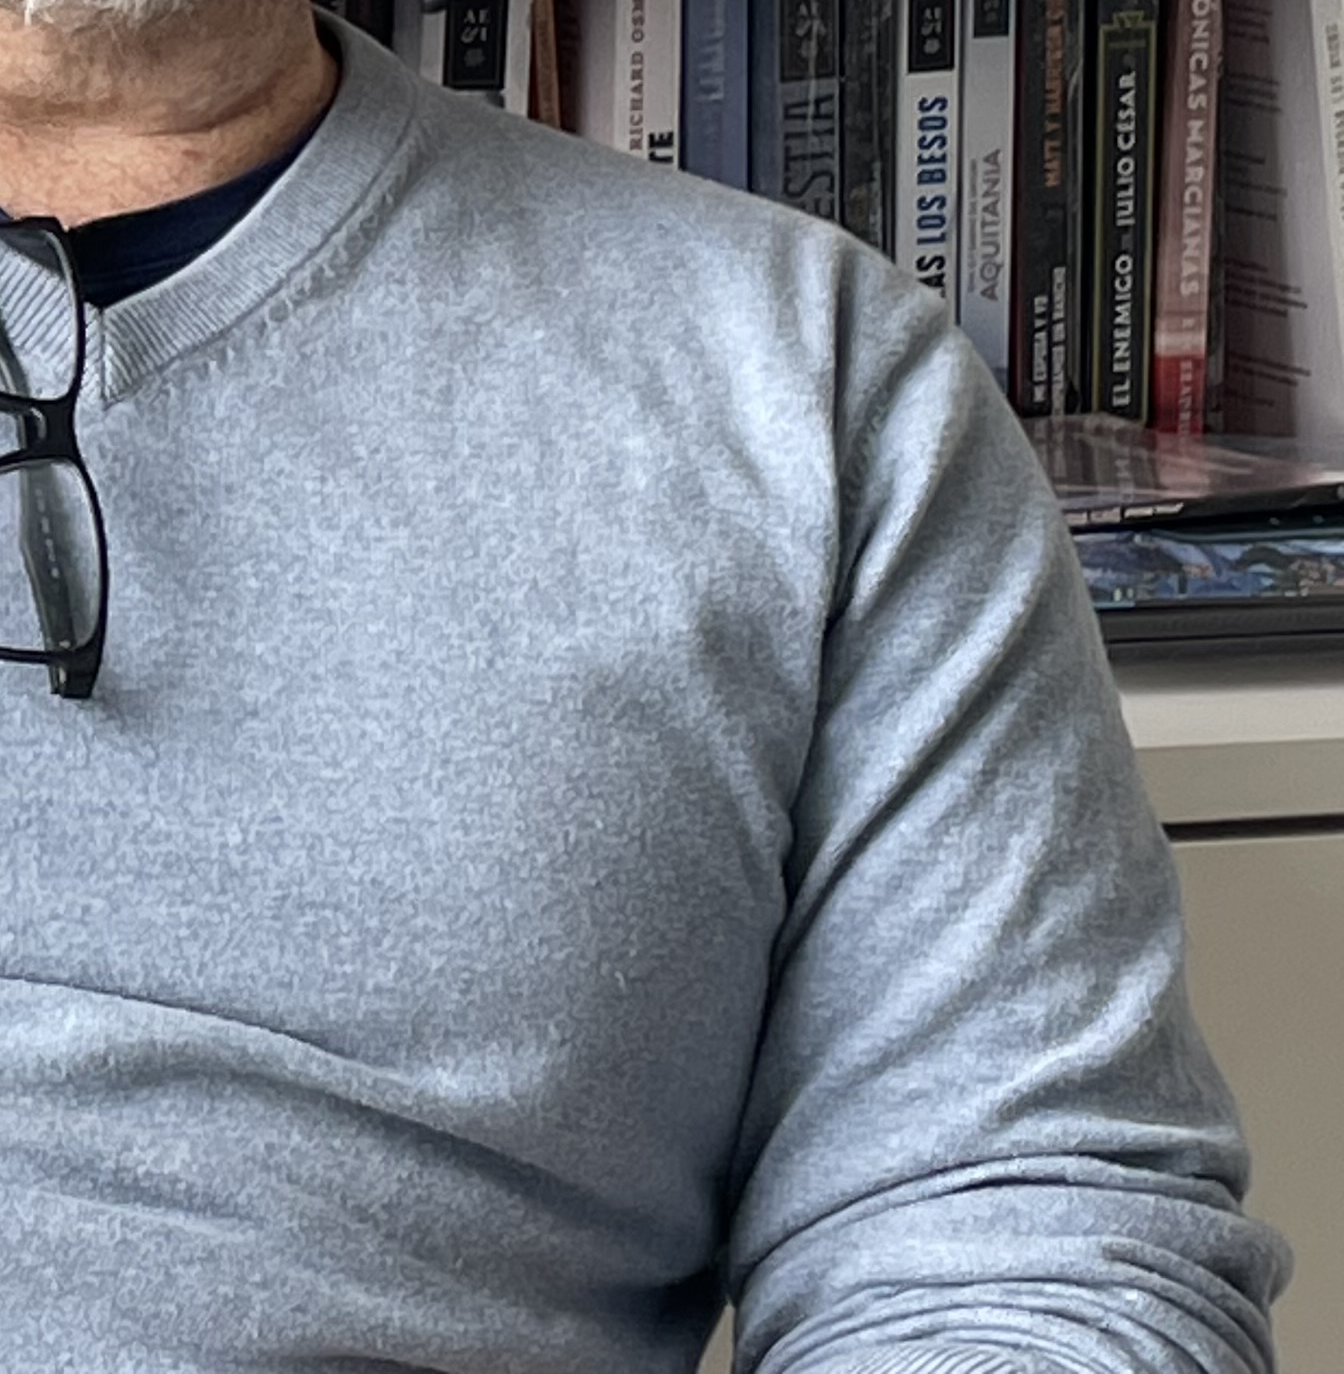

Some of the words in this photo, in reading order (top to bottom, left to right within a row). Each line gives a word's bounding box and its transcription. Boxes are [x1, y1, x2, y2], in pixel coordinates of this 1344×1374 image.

[628, 50, 646, 152] RICHARD
[915, 96, 948, 185] BESOS
[1111, 70, 1137, 151] CÉSAR
[915, 194, 948, 246] LOS
[977, 148, 1010, 302] AQUITANIA
[1114, 156, 1136, 227] JULIO
[1179, 118, 1206, 297] MARCIANAS
[1112, 253, 1133, 373] ENEMIGO
[1111, 378, 1131, 407] EL
